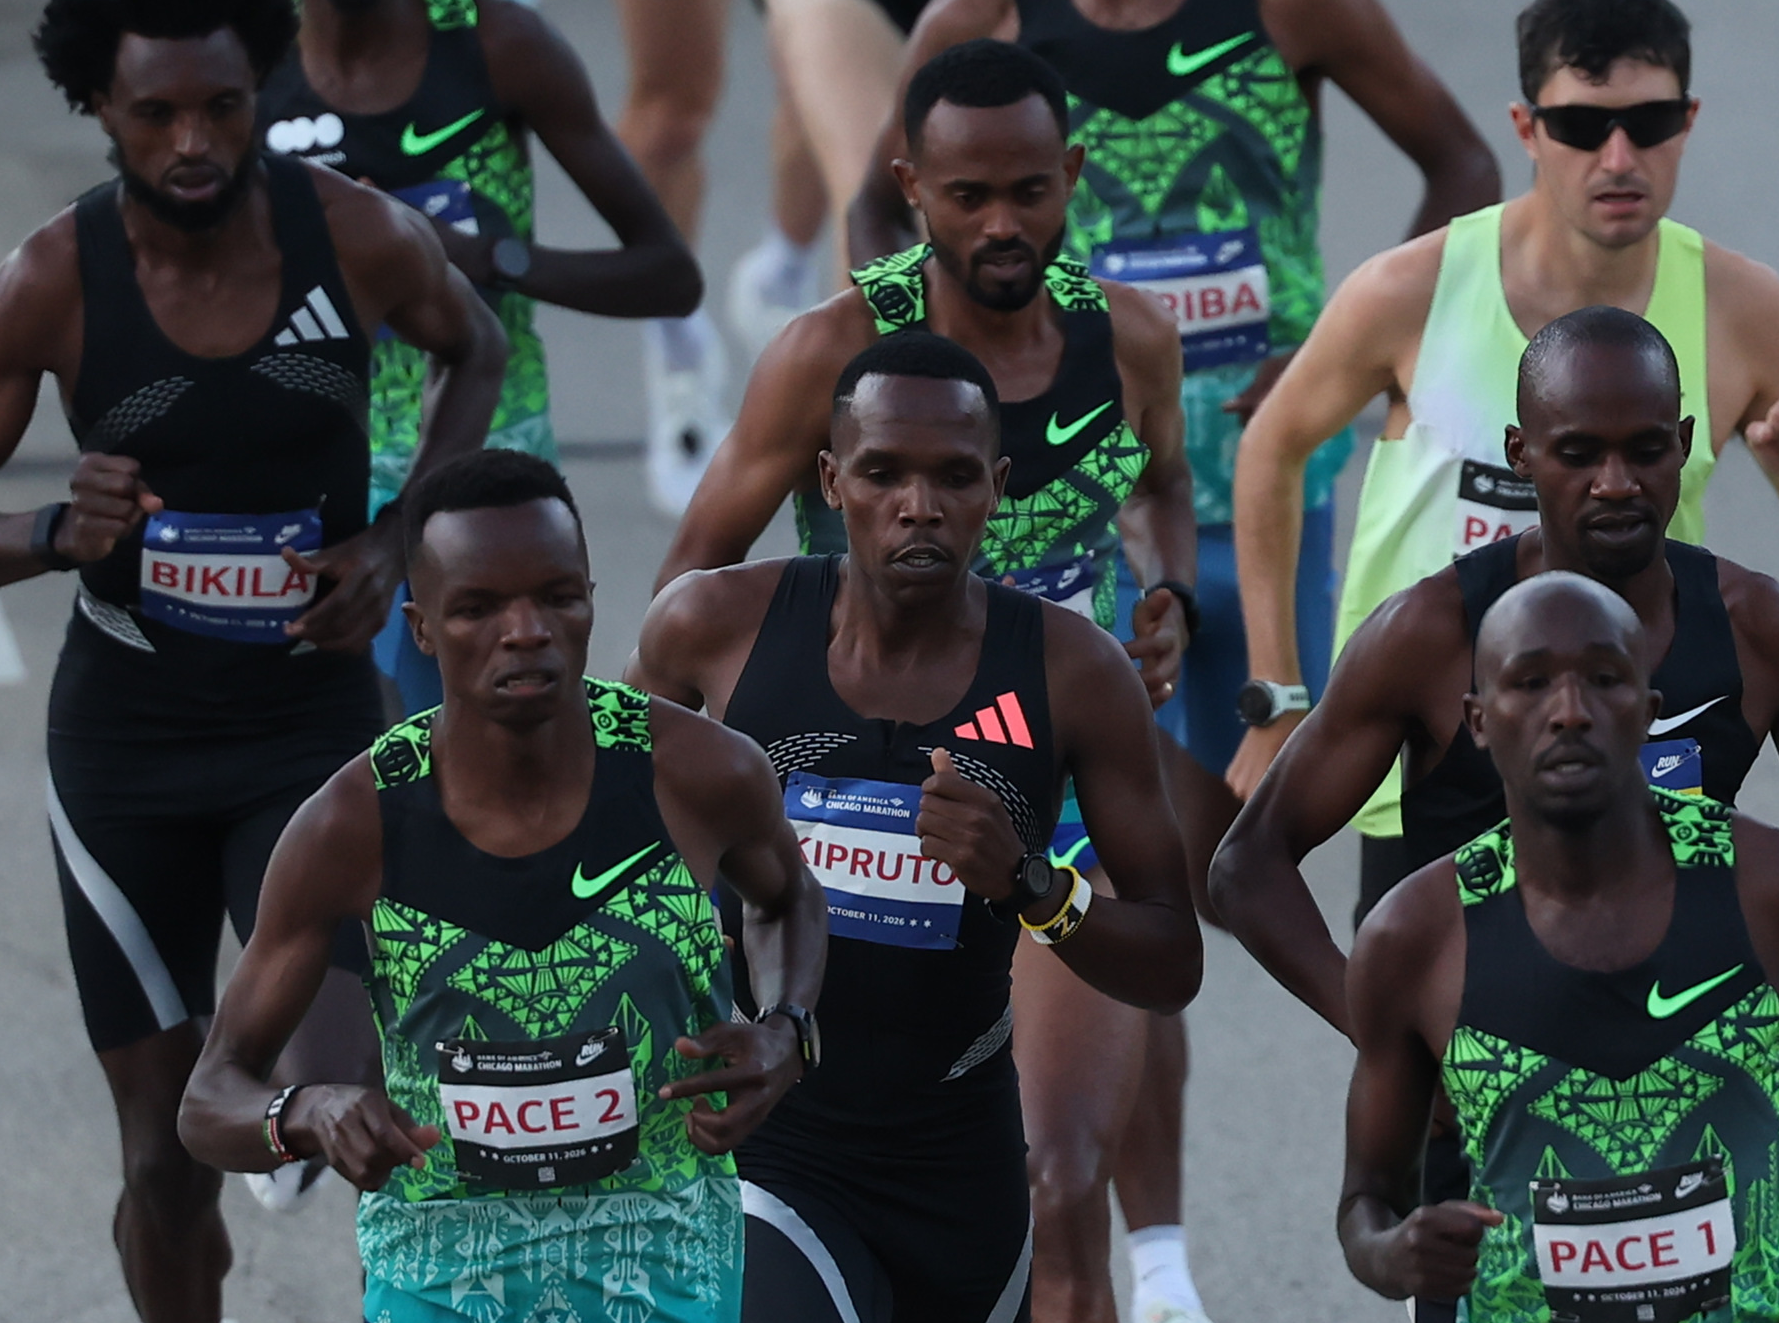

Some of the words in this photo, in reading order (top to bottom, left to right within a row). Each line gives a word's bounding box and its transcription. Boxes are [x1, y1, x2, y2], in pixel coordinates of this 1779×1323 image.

[1159, 282, 1261, 321] RIBA
[151, 560, 309, 599] BIKILA
[1657, 755, 1681, 769] RUN
[857, 796, 889, 805] AMERICA
[826, 801, 861, 812] CHICAGO
[863, 805, 910, 818] MARATHON
[868, 913, 881, 923] 11,
[882, 915, 905, 926] 2026
[477, 1062, 513, 1071] CHICAGO
[514, 1060, 562, 1072] MARATHON
[454, 1097, 580, 1135] PACE
[595, 1088, 624, 1124] 2
[503, 1153, 546, 1163] OCTOBER
[564, 1149, 586, 1159] 2026
[1549, 1231, 1679, 1273] PACE
[1697, 1221, 1716, 1255] 1
